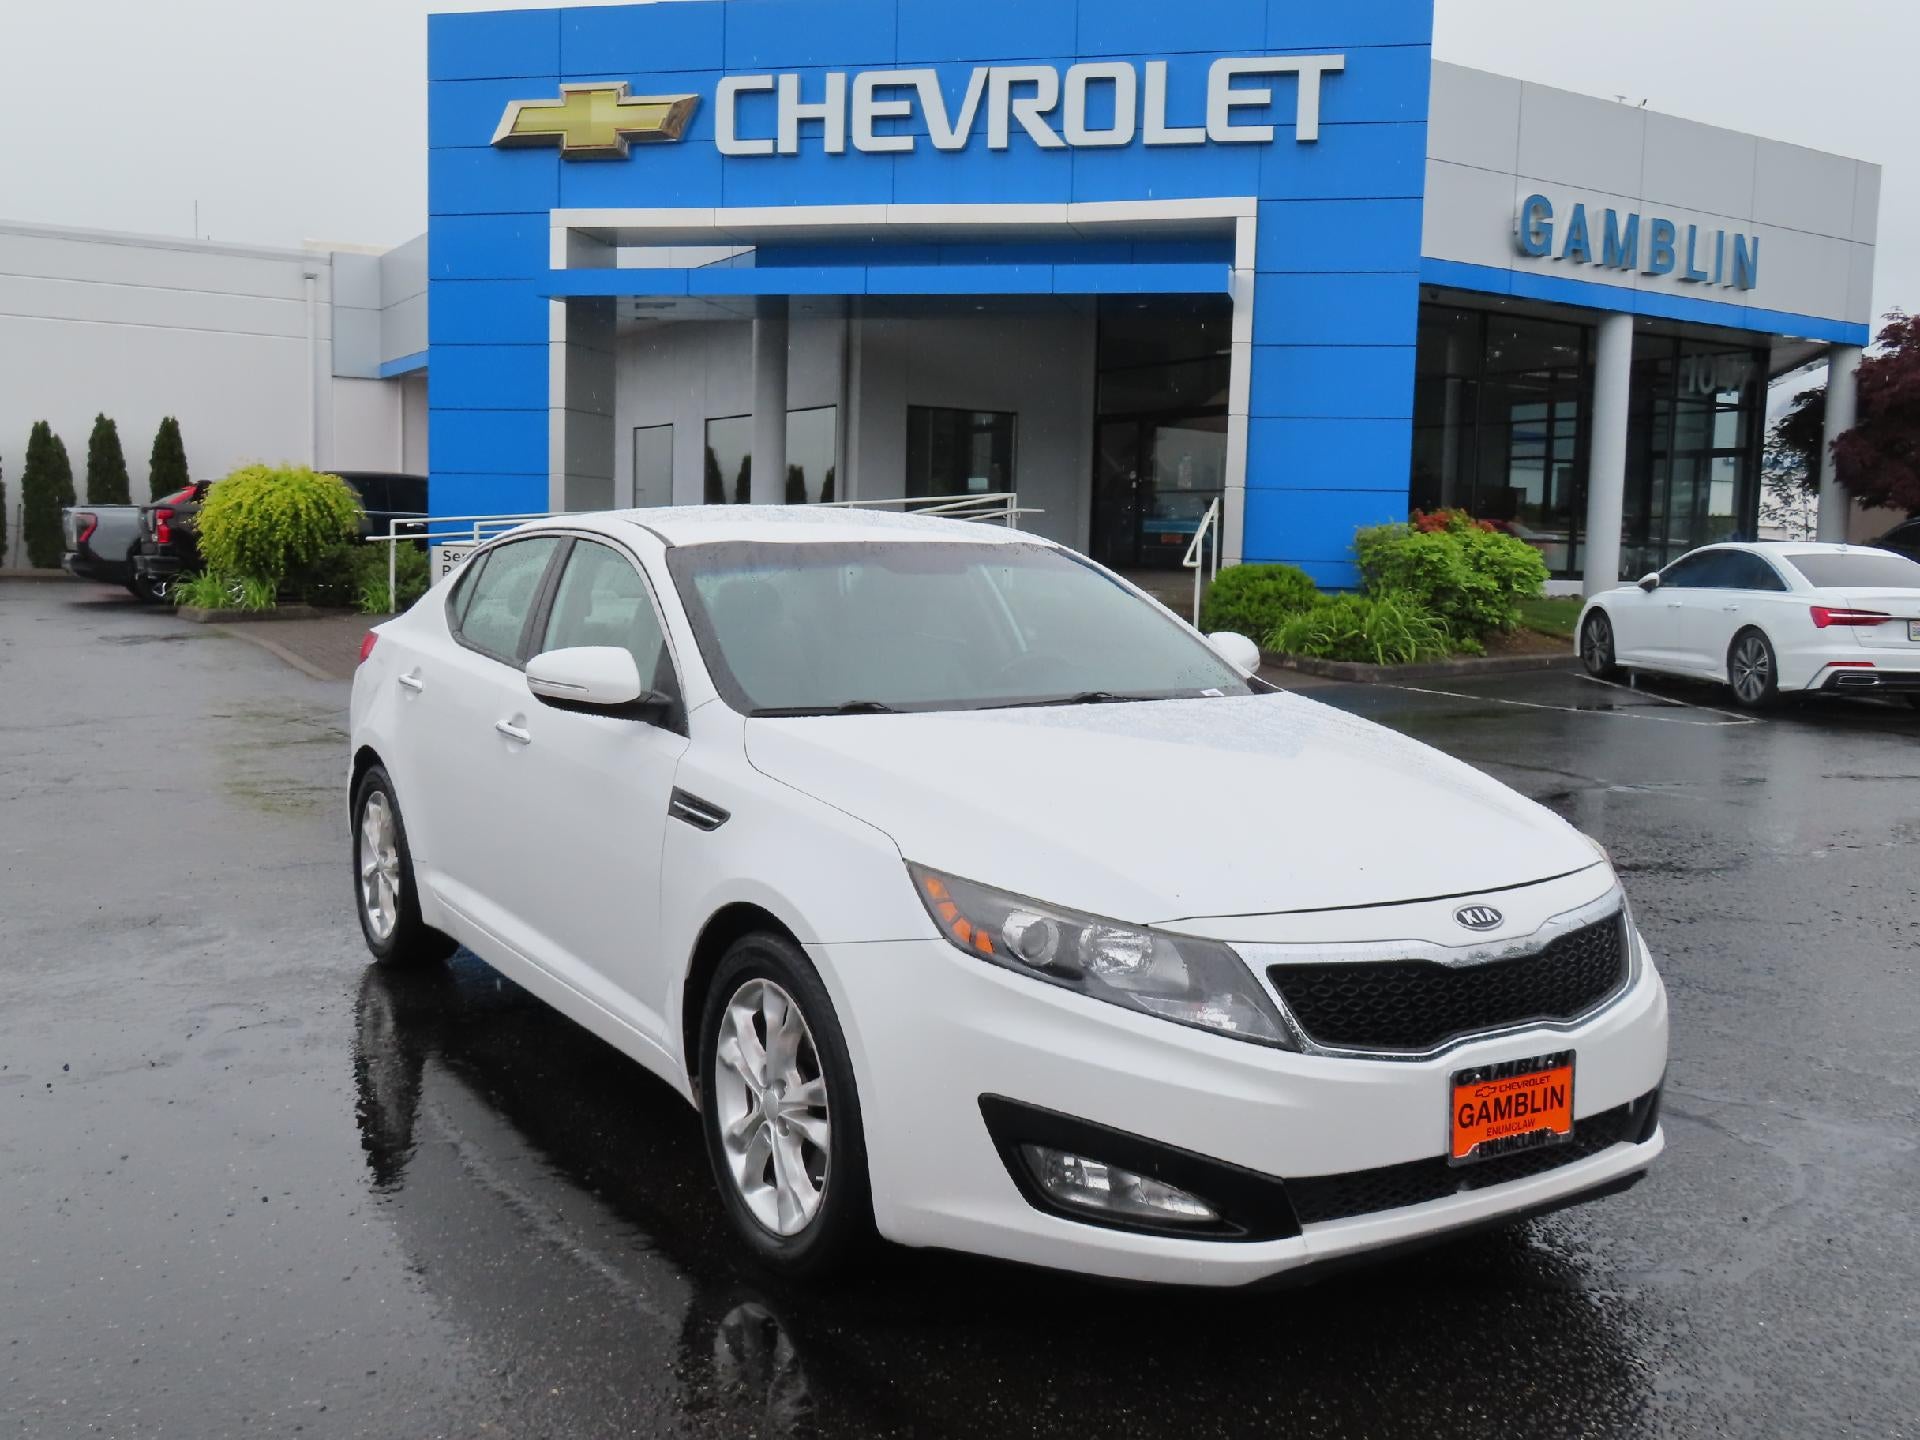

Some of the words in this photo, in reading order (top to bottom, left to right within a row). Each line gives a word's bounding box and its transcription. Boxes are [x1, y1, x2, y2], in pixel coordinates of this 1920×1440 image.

[714, 54, 1345, 154] CHEVROLET
[1514, 193, 1759, 291] GAMBLIN
[1455, 903, 1499, 924] KIA
[1499, 1075, 1551, 1093] CHEVROLET
[1457, 1084, 1565, 1129] GAMBLIN
[1486, 1118, 1536, 1137] ENUMCLAW
